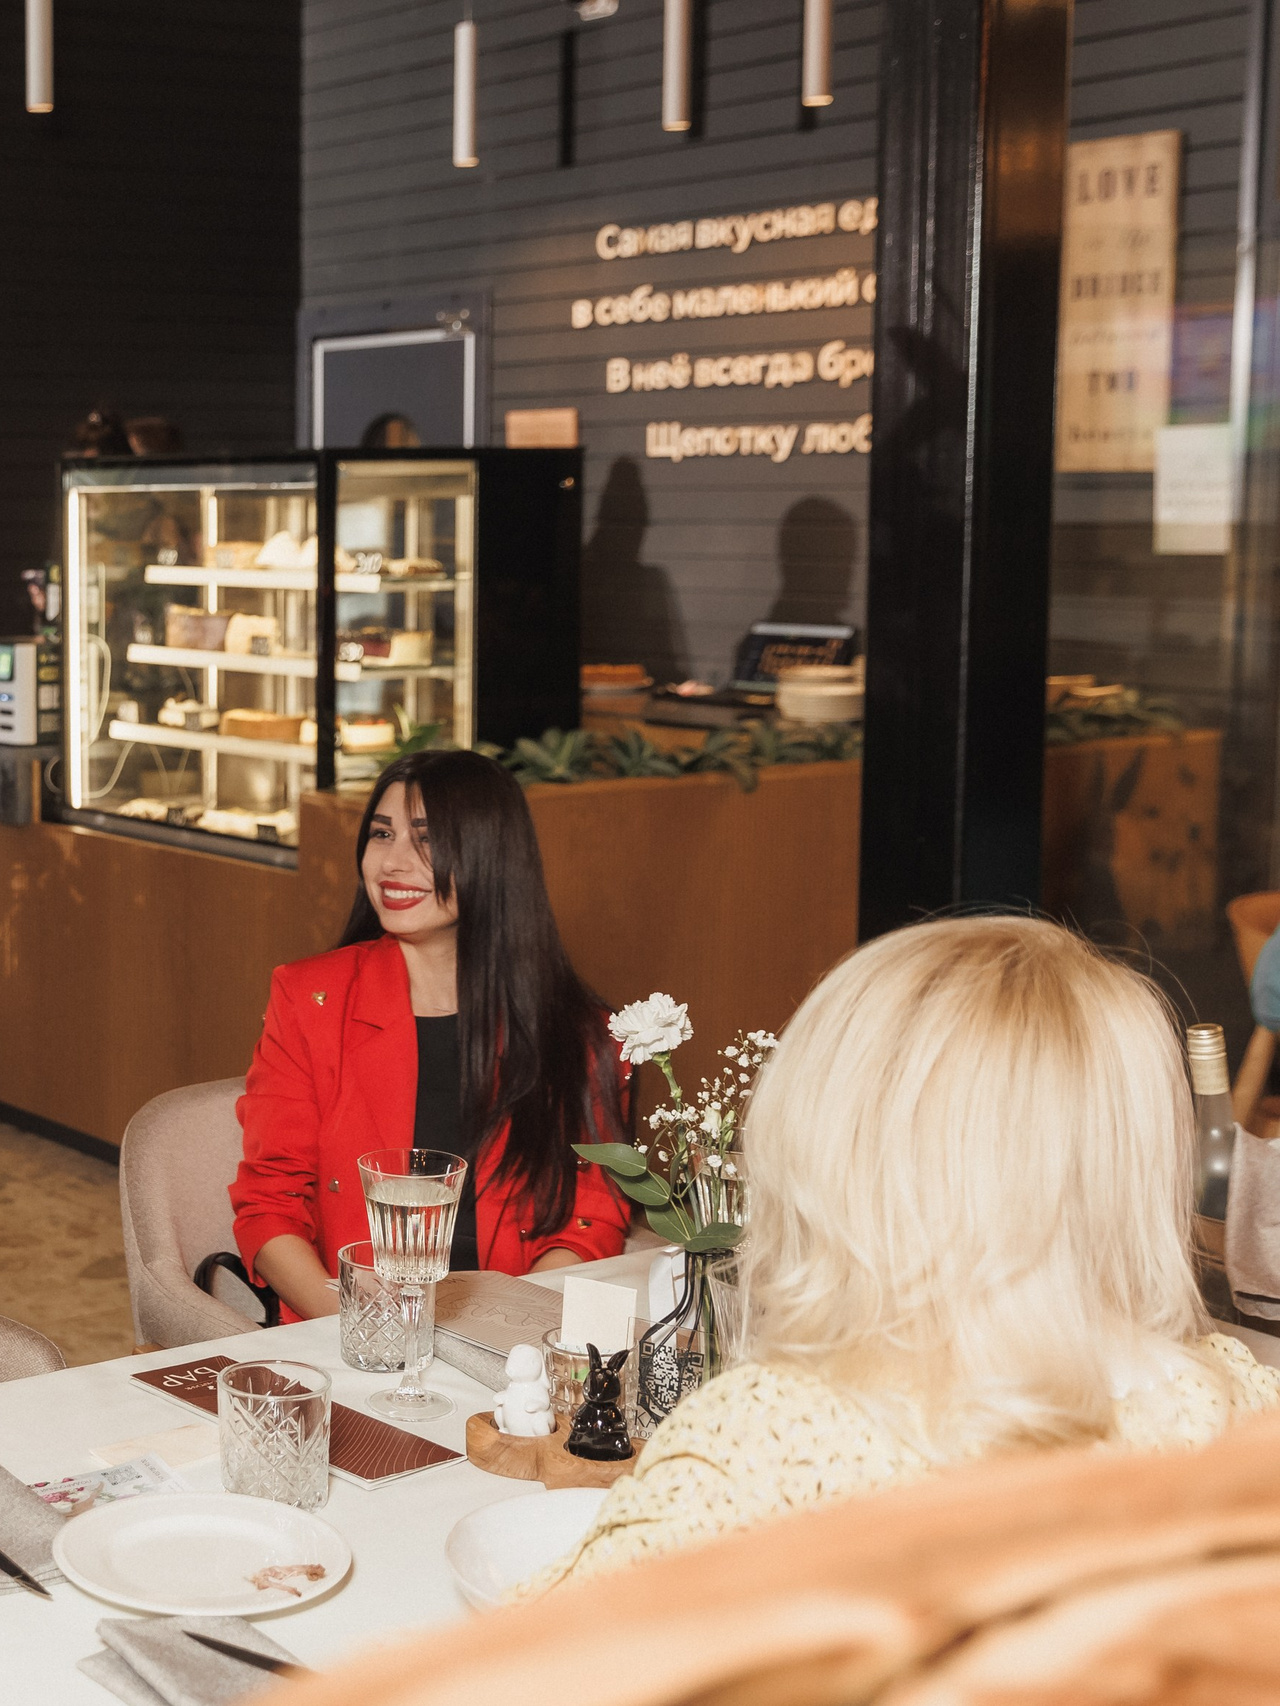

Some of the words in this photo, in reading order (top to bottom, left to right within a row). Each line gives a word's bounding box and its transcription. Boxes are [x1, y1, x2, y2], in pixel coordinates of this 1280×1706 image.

[1077, 164, 1160, 205] LOVE
[596, 222, 693, 260] Самая
[694, 202, 835, 253] вкусная
[571, 299, 593, 329] в
[594, 284, 670, 326] себе
[671, 267, 859, 320] маленький
[606, 357, 631, 393] В
[632, 352, 692, 391] неё
[693, 351, 814, 388] всегда
[646, 421, 798, 462] Щепотку
[162, 1366, 219, 1387] БАР
